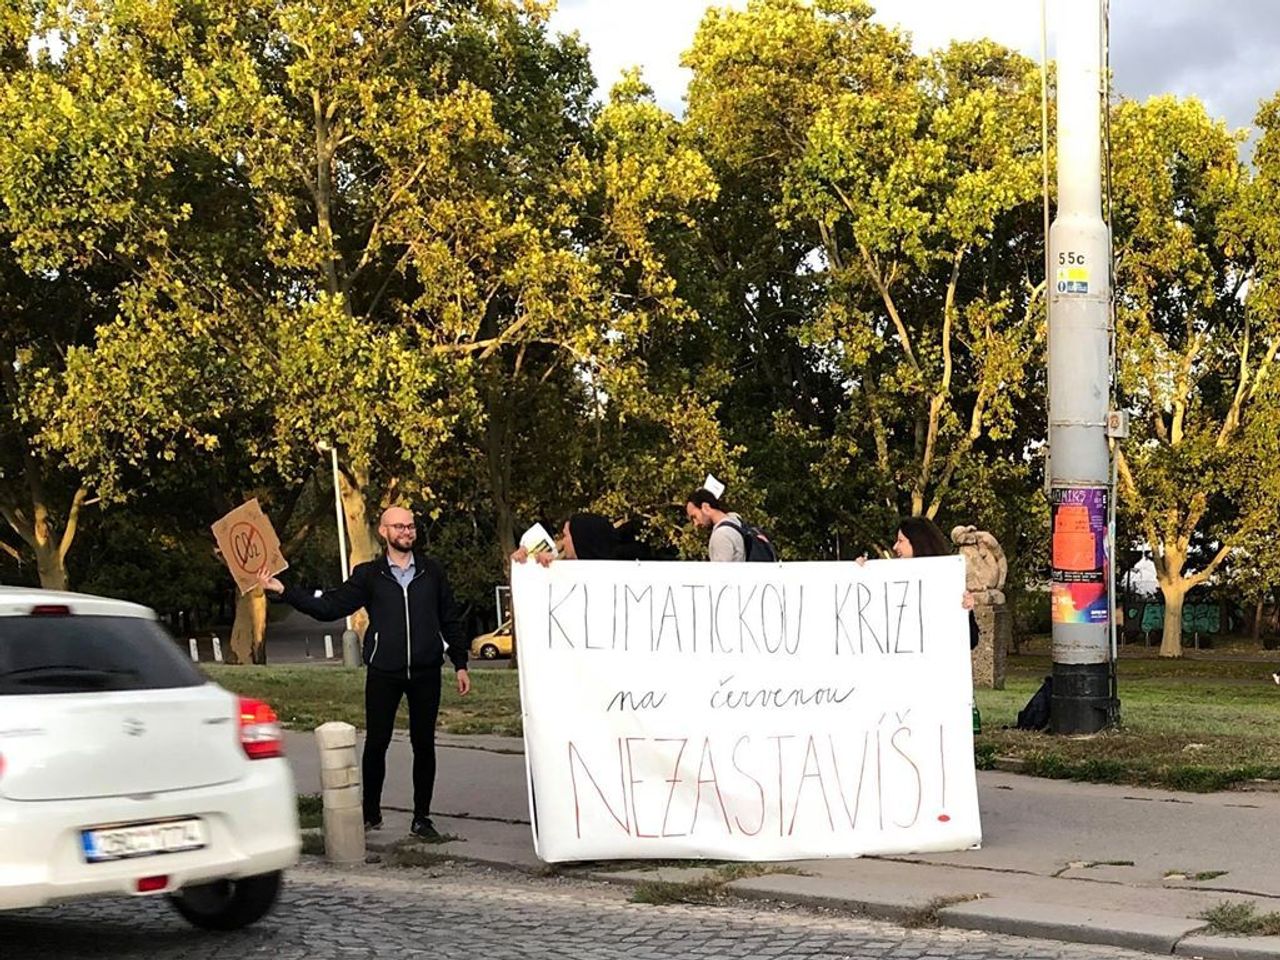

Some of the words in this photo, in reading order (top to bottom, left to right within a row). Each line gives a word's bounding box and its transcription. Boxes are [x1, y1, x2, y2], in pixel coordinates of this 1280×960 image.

[548, 583, 804, 655] KLIMATICKOU
[834, 579, 925, 656] KRIZI
[607, 689, 668, 713] na
[709, 674, 857, 710] červenou
